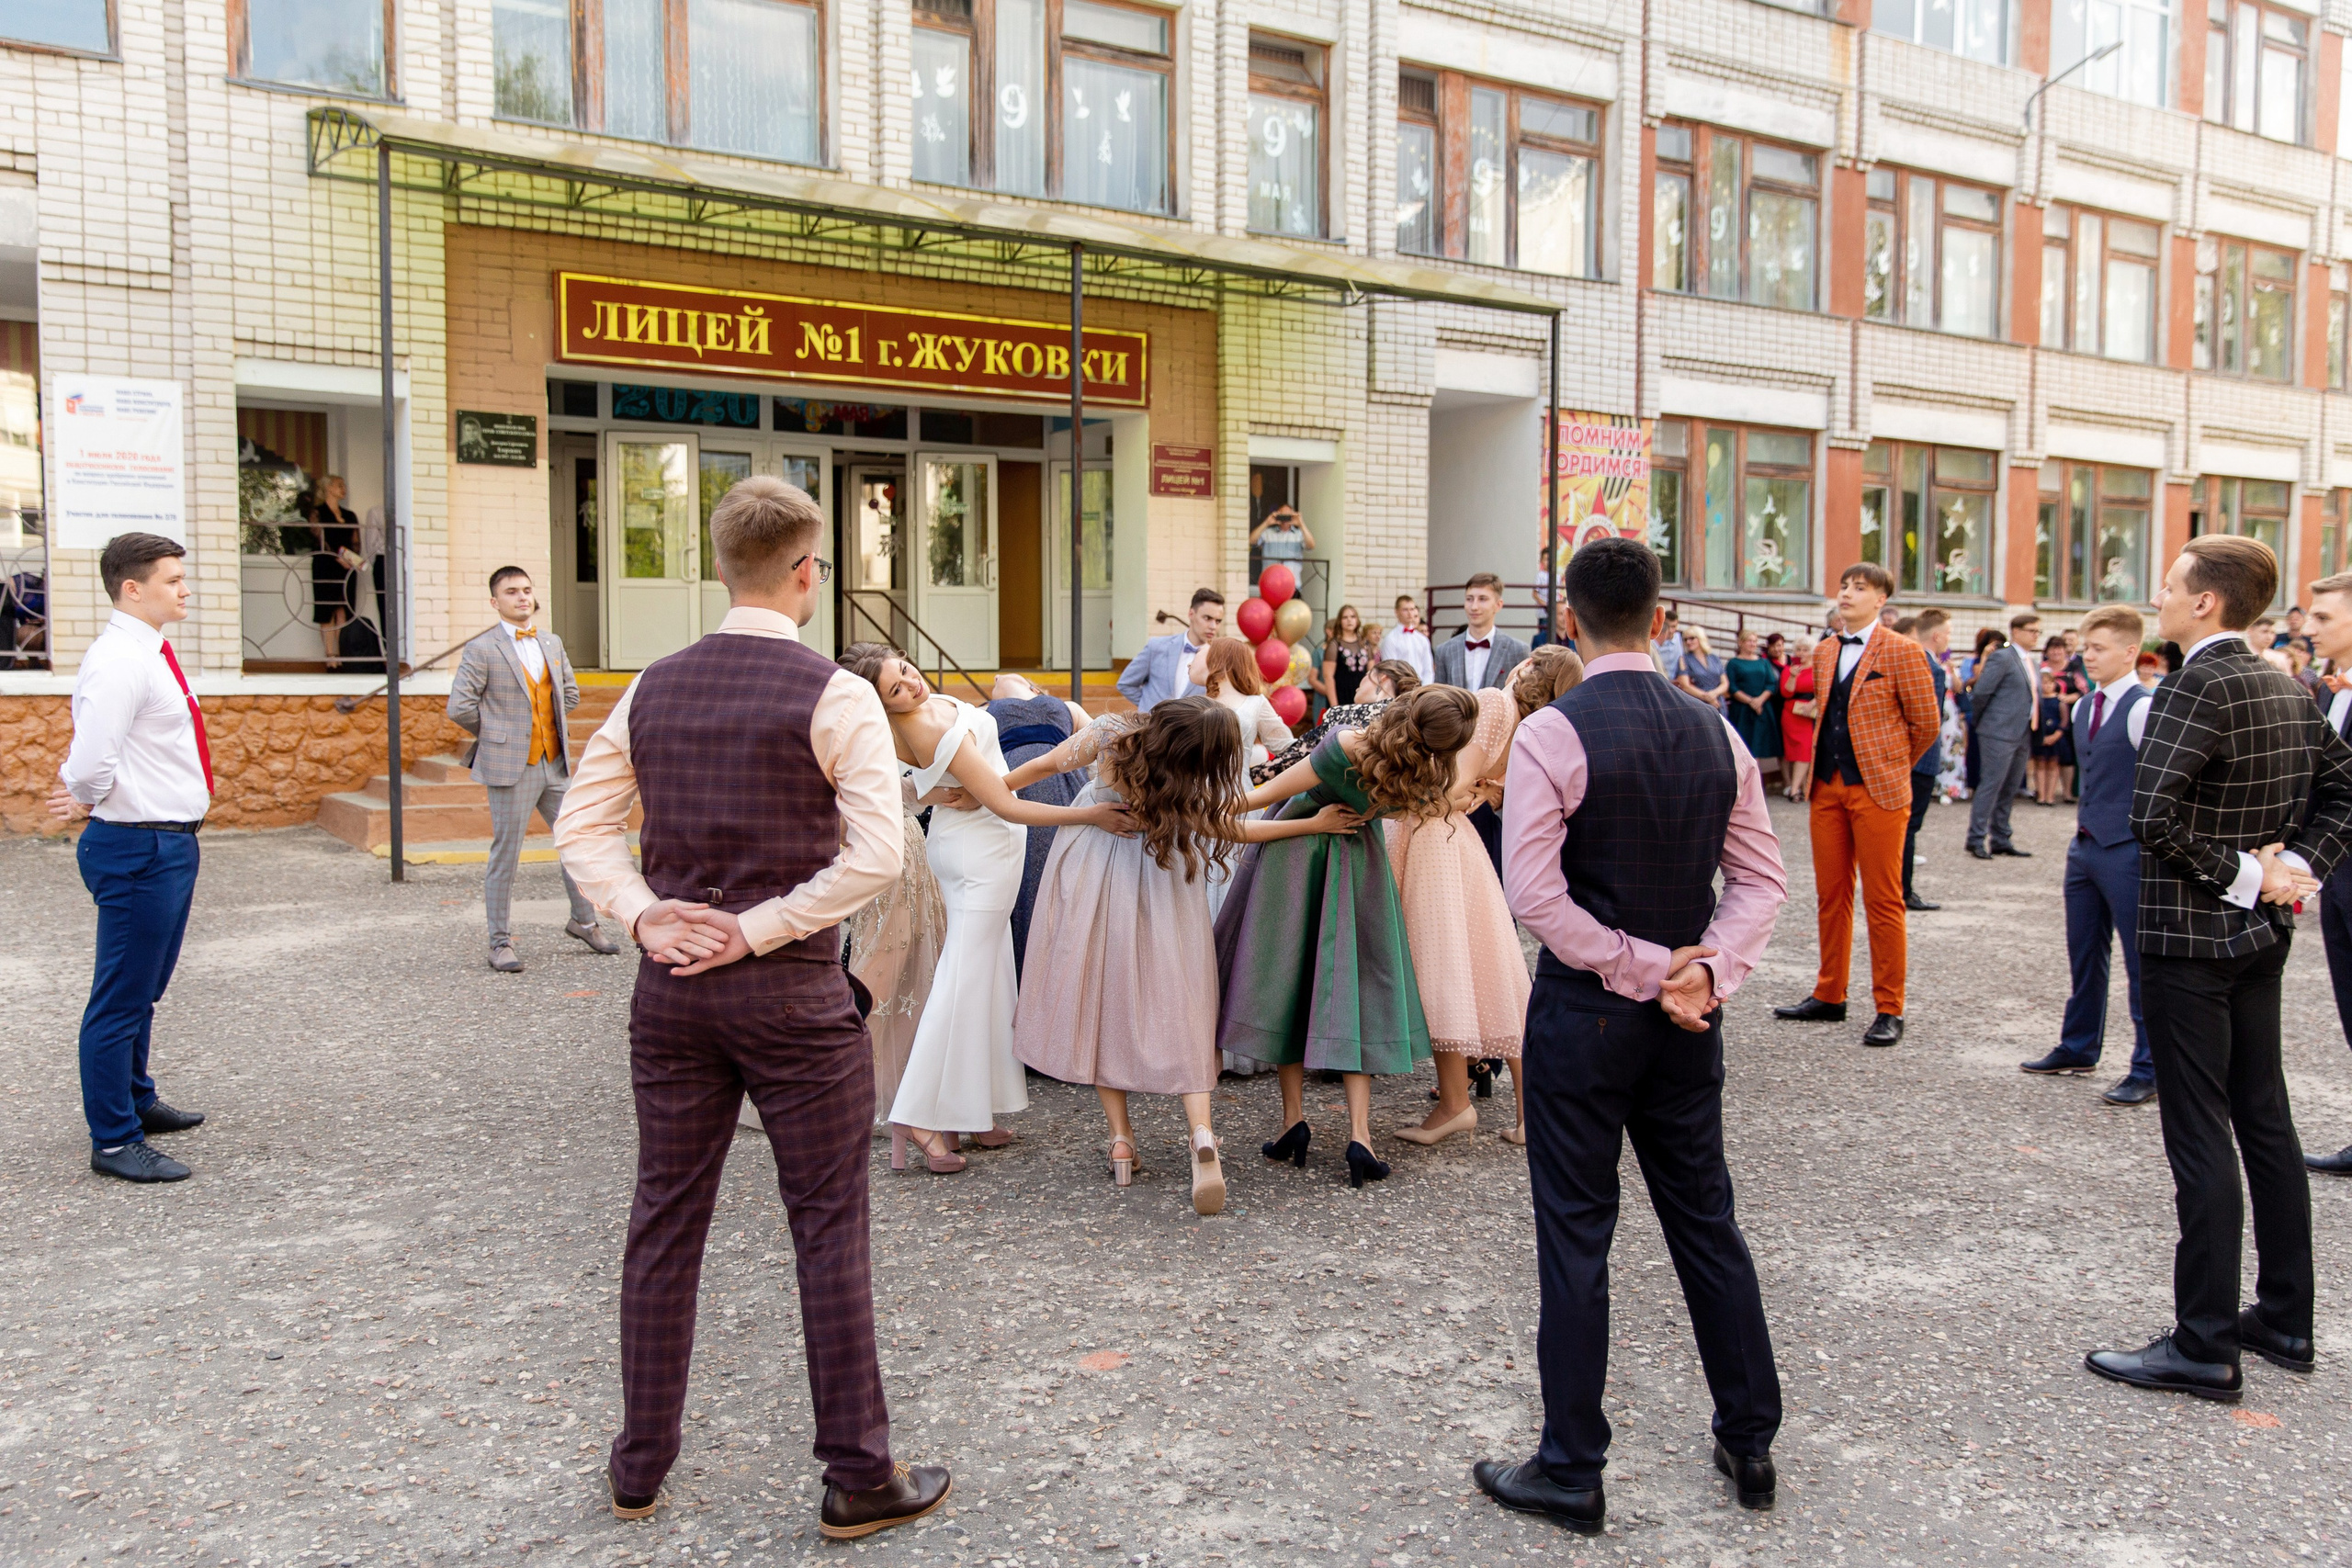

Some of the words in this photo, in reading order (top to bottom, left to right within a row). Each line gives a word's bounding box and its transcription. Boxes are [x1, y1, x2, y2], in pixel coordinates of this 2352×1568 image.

[1000, 83, 1028, 130] 9
[1262, 114, 1288, 158] 9
[1260, 181, 1292, 202] МАЯ
[1473, 157, 1494, 197] 9
[1710, 206, 1727, 242] 9
[582, 299, 773, 359] ЛИЦЕЙ
[795, 321, 864, 364] №1
[613, 383, 759, 425] 2020
[804, 400, 822, 433] 9
[1557, 423, 1643, 452] ПОМНИМ
[116, 451, 139, 461] 2020
[1160, 473, 1190, 486] ЛИЦЕЙ
